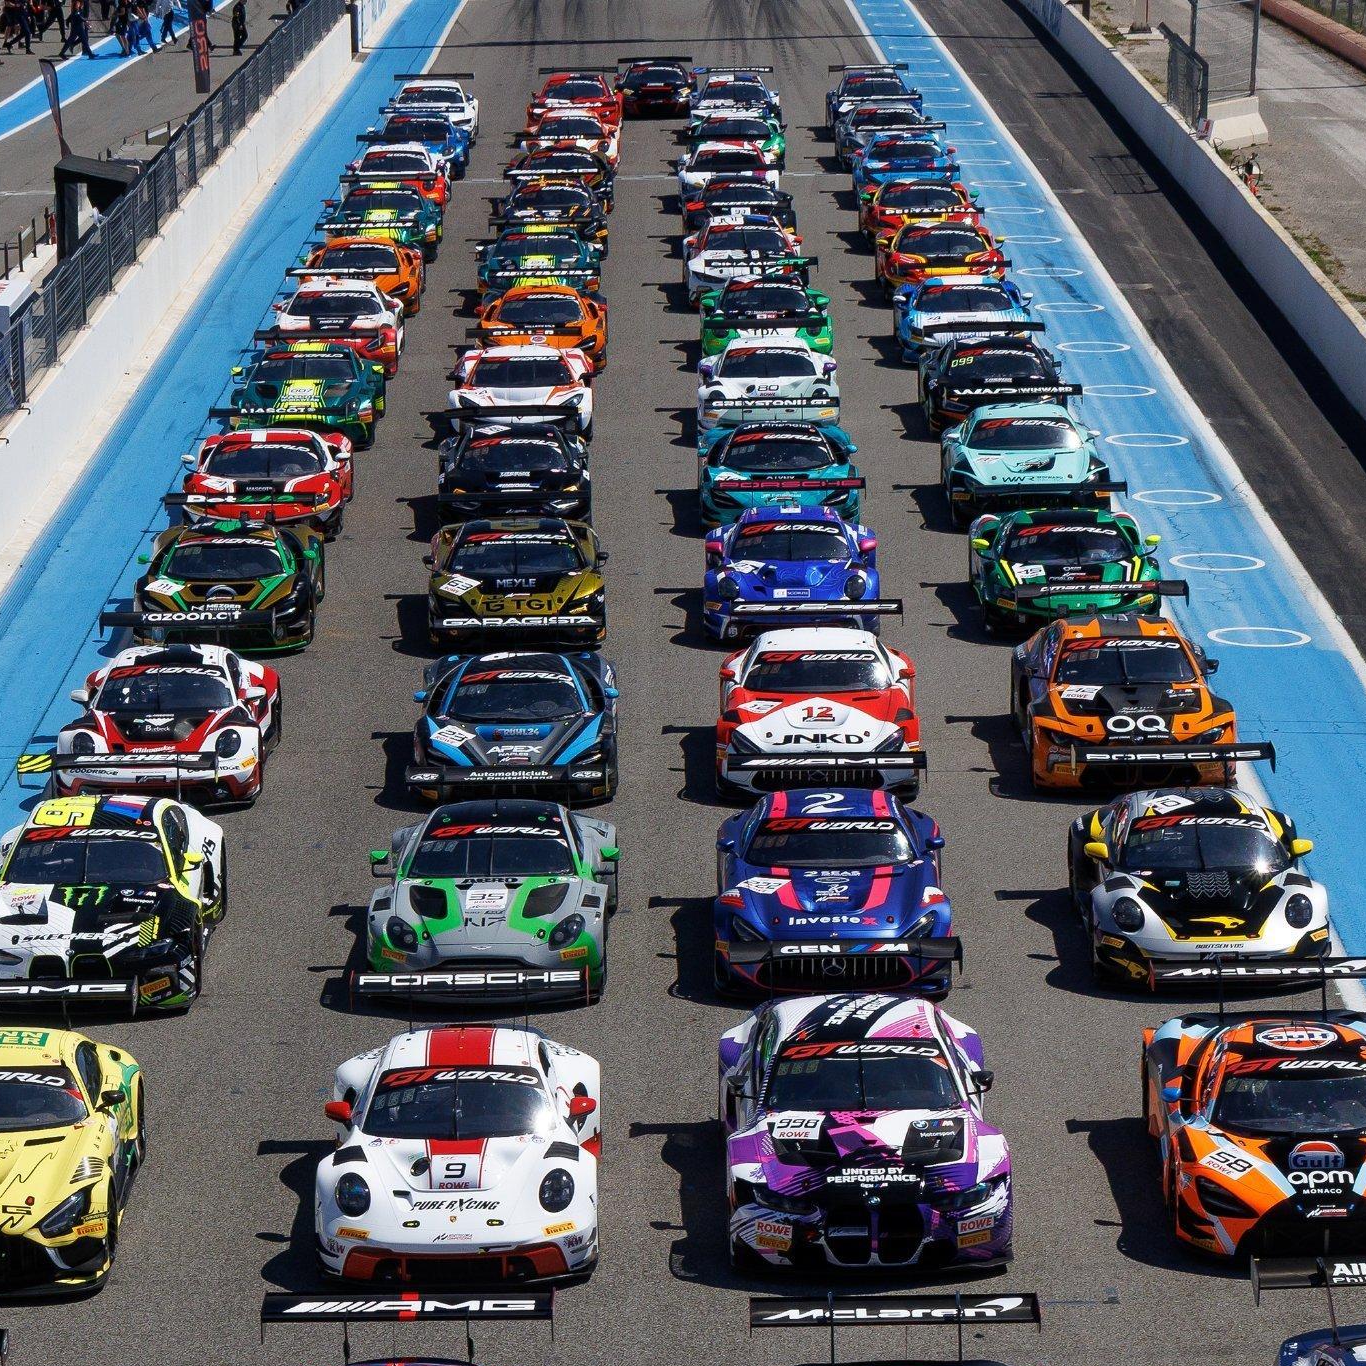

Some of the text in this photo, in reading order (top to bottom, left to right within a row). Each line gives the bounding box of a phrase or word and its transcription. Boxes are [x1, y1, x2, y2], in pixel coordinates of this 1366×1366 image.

[496, 578, 536, 588] MEYLE
[802, 707, 833, 718] 12
[1106, 714, 1170, 733] OQ
[773, 734, 864, 745] JNKD
[486, 745, 543, 754] APEX
[76, 754, 201, 762] SKECHERS
[1086, 751, 1262, 760] PORSCHE
[781, 945, 841, 954] GEN
[1162, 966, 1354, 976] McLaren
[359, 971, 581, 986] PORSCHE
[776, 1118, 819, 1129] 998
[779, 1130, 810, 1138] ROWE
[1209, 1152, 1253, 1172] 58
[444, 1162, 467, 1179] 9
[886, 1167, 904, 1175] BY
[1206, 1161, 1233, 1175] ROWE
[827, 1173, 921, 1183] PERFORMANCE.
[1288, 1170, 1354, 1188] apm
[438, 1182, 470, 1190] ROWE
[412, 1201, 445, 1211] PURE
[76, 1223, 105, 1235] PIRELLI
[545, 1224, 574, 1235] PIRELLI
[757, 1221, 791, 1236] ROWE
[960, 1218, 993, 1232] ROWE
[368, 1300, 535, 1312] AMG
[763, 1307, 998, 1321] McLaren
